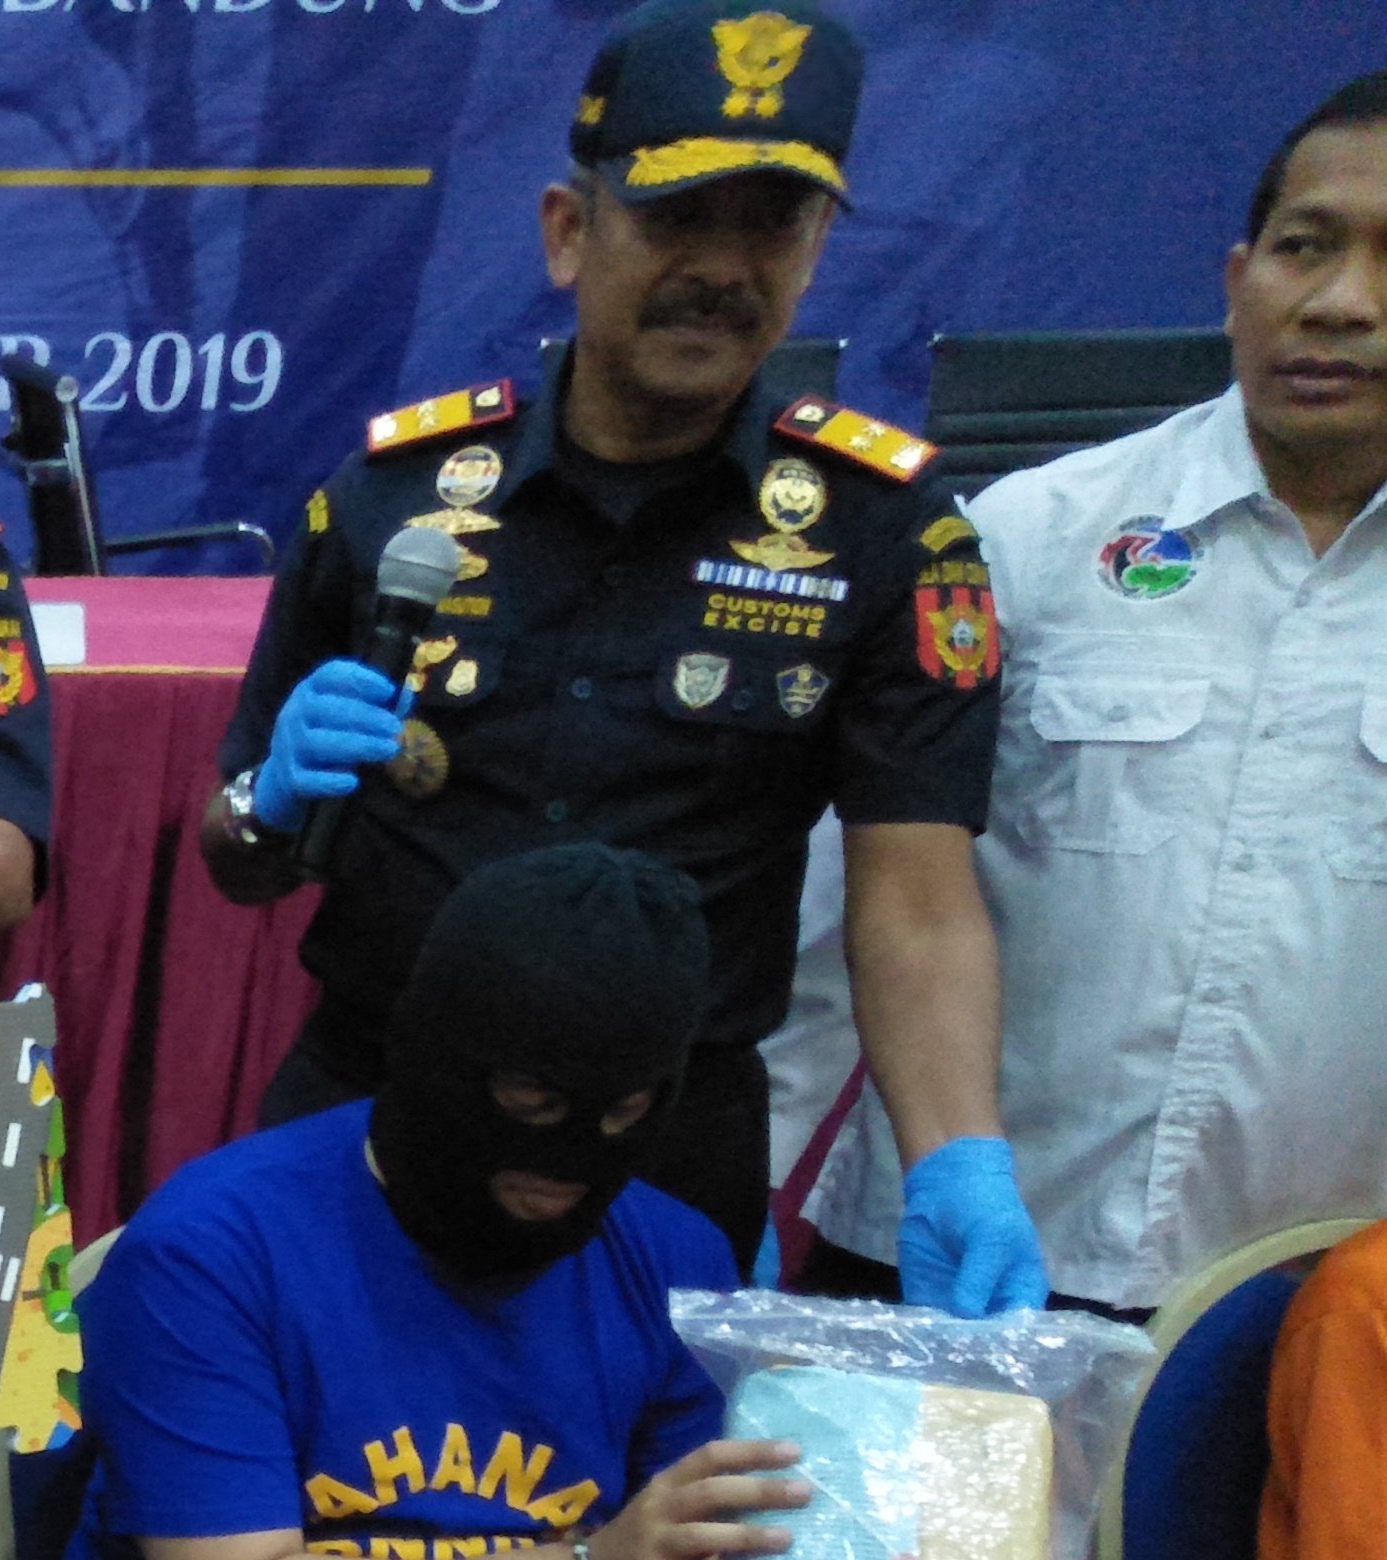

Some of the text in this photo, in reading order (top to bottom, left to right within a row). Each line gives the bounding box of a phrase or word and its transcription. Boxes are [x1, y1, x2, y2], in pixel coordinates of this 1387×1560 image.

[77, 329, 285, 413] 2019
[708, 593, 826, 620] CUSTOMS
[703, 611, 823, 638] EXCISE
